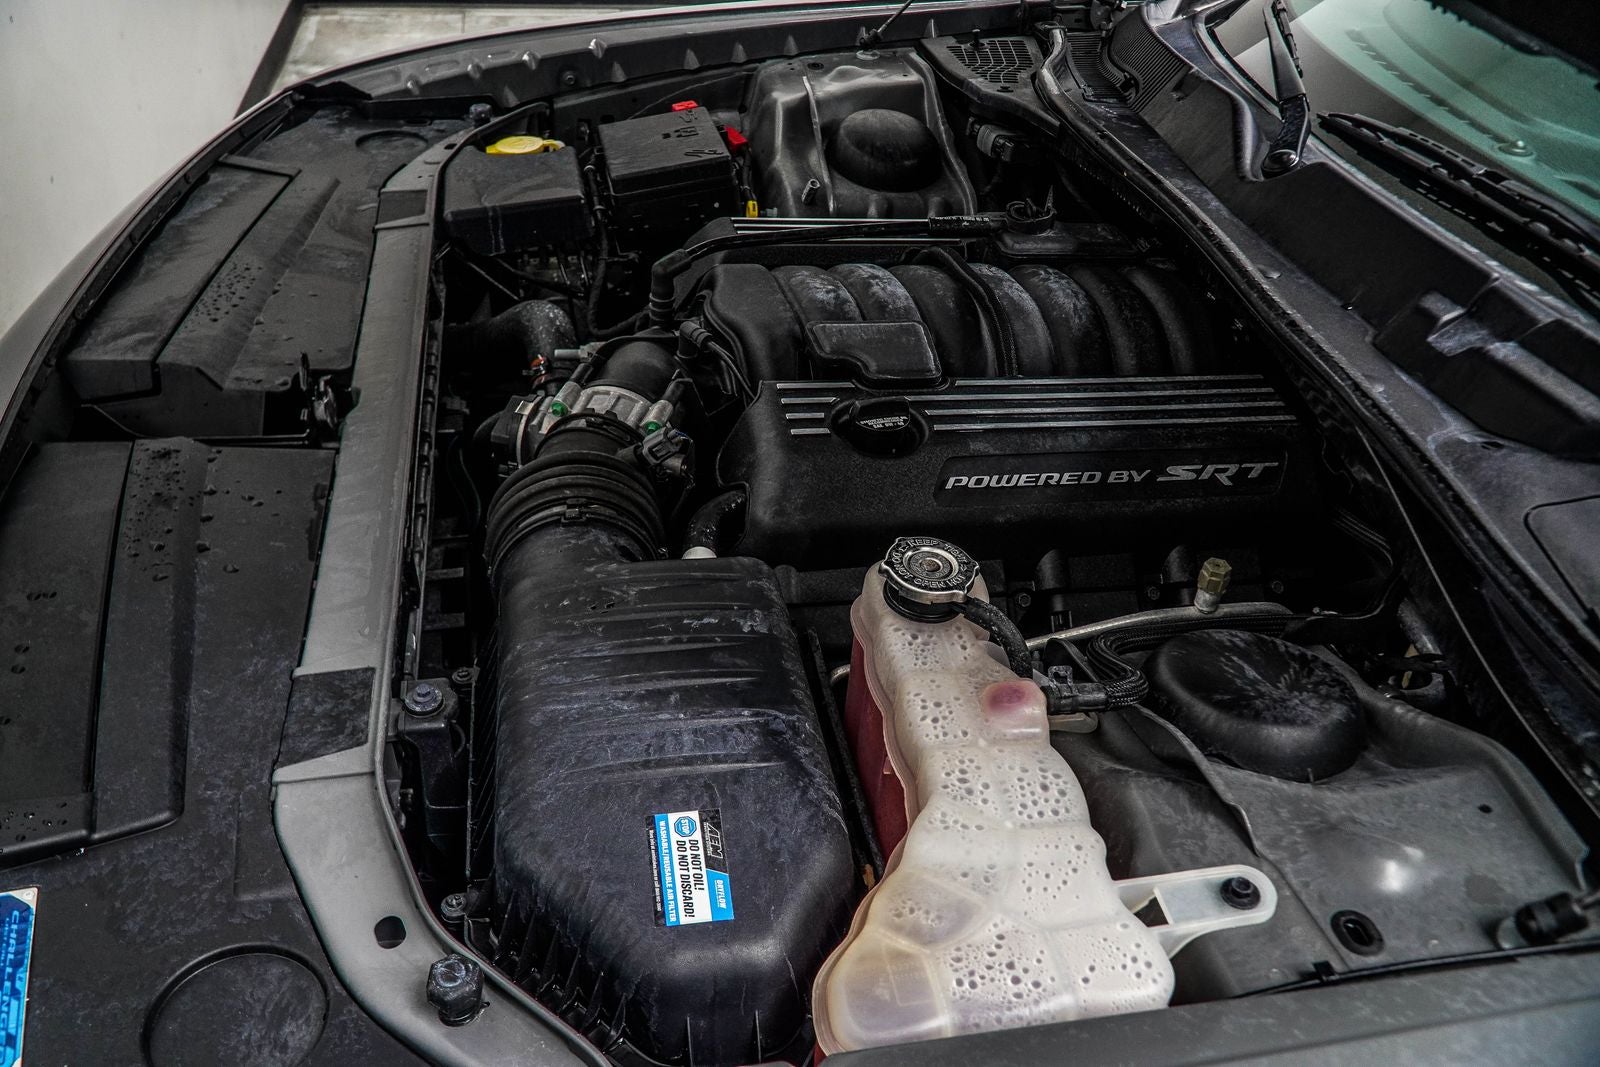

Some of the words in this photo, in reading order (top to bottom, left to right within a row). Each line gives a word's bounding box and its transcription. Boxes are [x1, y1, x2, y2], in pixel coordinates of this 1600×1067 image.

[944, 470, 1102, 490] POWERED
[1107, 469, 1152, 484] BY
[1156, 462, 1280, 486] SRT
[913, 578, 947, 589] OPEN
[681, 818, 690, 834] STOP
[676, 840, 687, 852] DO
[688, 839, 700, 852] DO
[708, 822, 723, 859] AEM
[660, 820, 673, 888] WASHABLE/REUSABLE
[678, 854, 690, 872] NOT
[690, 854, 702, 871] NOT
[693, 873, 705, 891] OIL!
[666, 889, 675, 900] AIR
[680, 874, 695, 918] DISCARD!
[717, 879, 727, 909] DRYFLOW
[667, 901, 677, 922] FILTER
